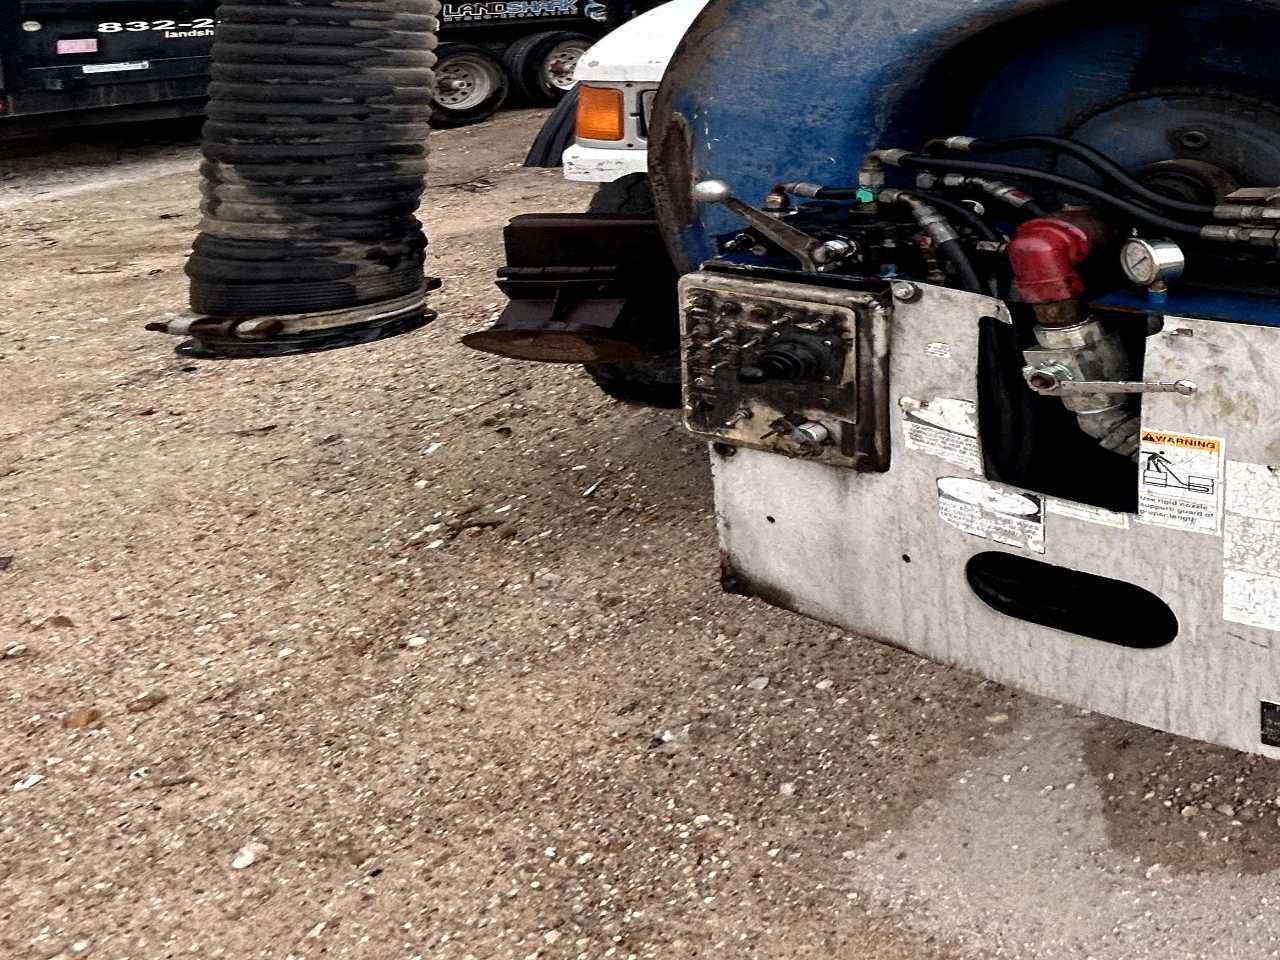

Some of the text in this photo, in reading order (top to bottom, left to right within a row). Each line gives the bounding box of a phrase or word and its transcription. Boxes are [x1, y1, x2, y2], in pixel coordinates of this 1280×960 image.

[443, 0, 579, 17] LANDSHARK
[97, 17, 223, 33] 832-2
[1155, 435, 1216, 449] WARNING
